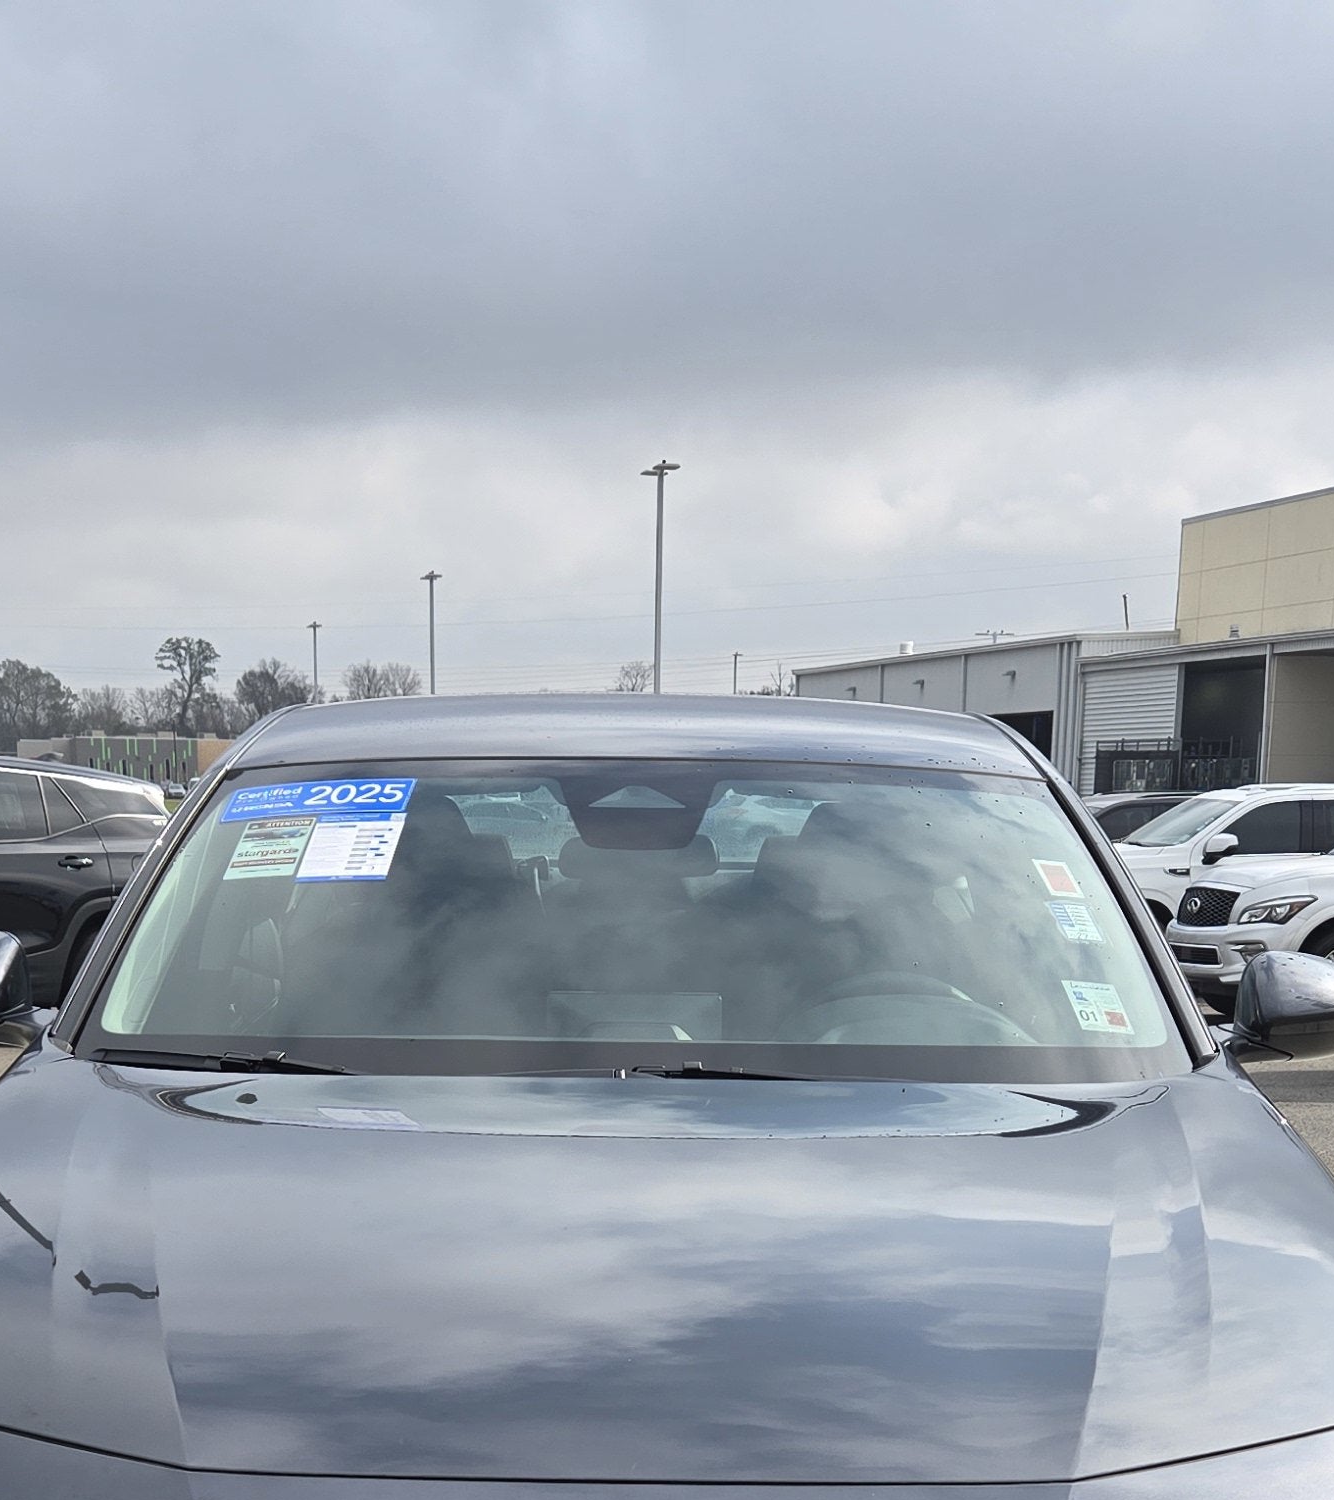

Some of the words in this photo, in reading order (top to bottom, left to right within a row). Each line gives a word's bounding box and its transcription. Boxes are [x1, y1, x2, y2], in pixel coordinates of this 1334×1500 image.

[238, 786, 303, 800] Certified
[303, 783, 407, 805] 2025
[266, 820, 312, 829] ATTENTION
[1079, 1009, 1098, 1022] 01
